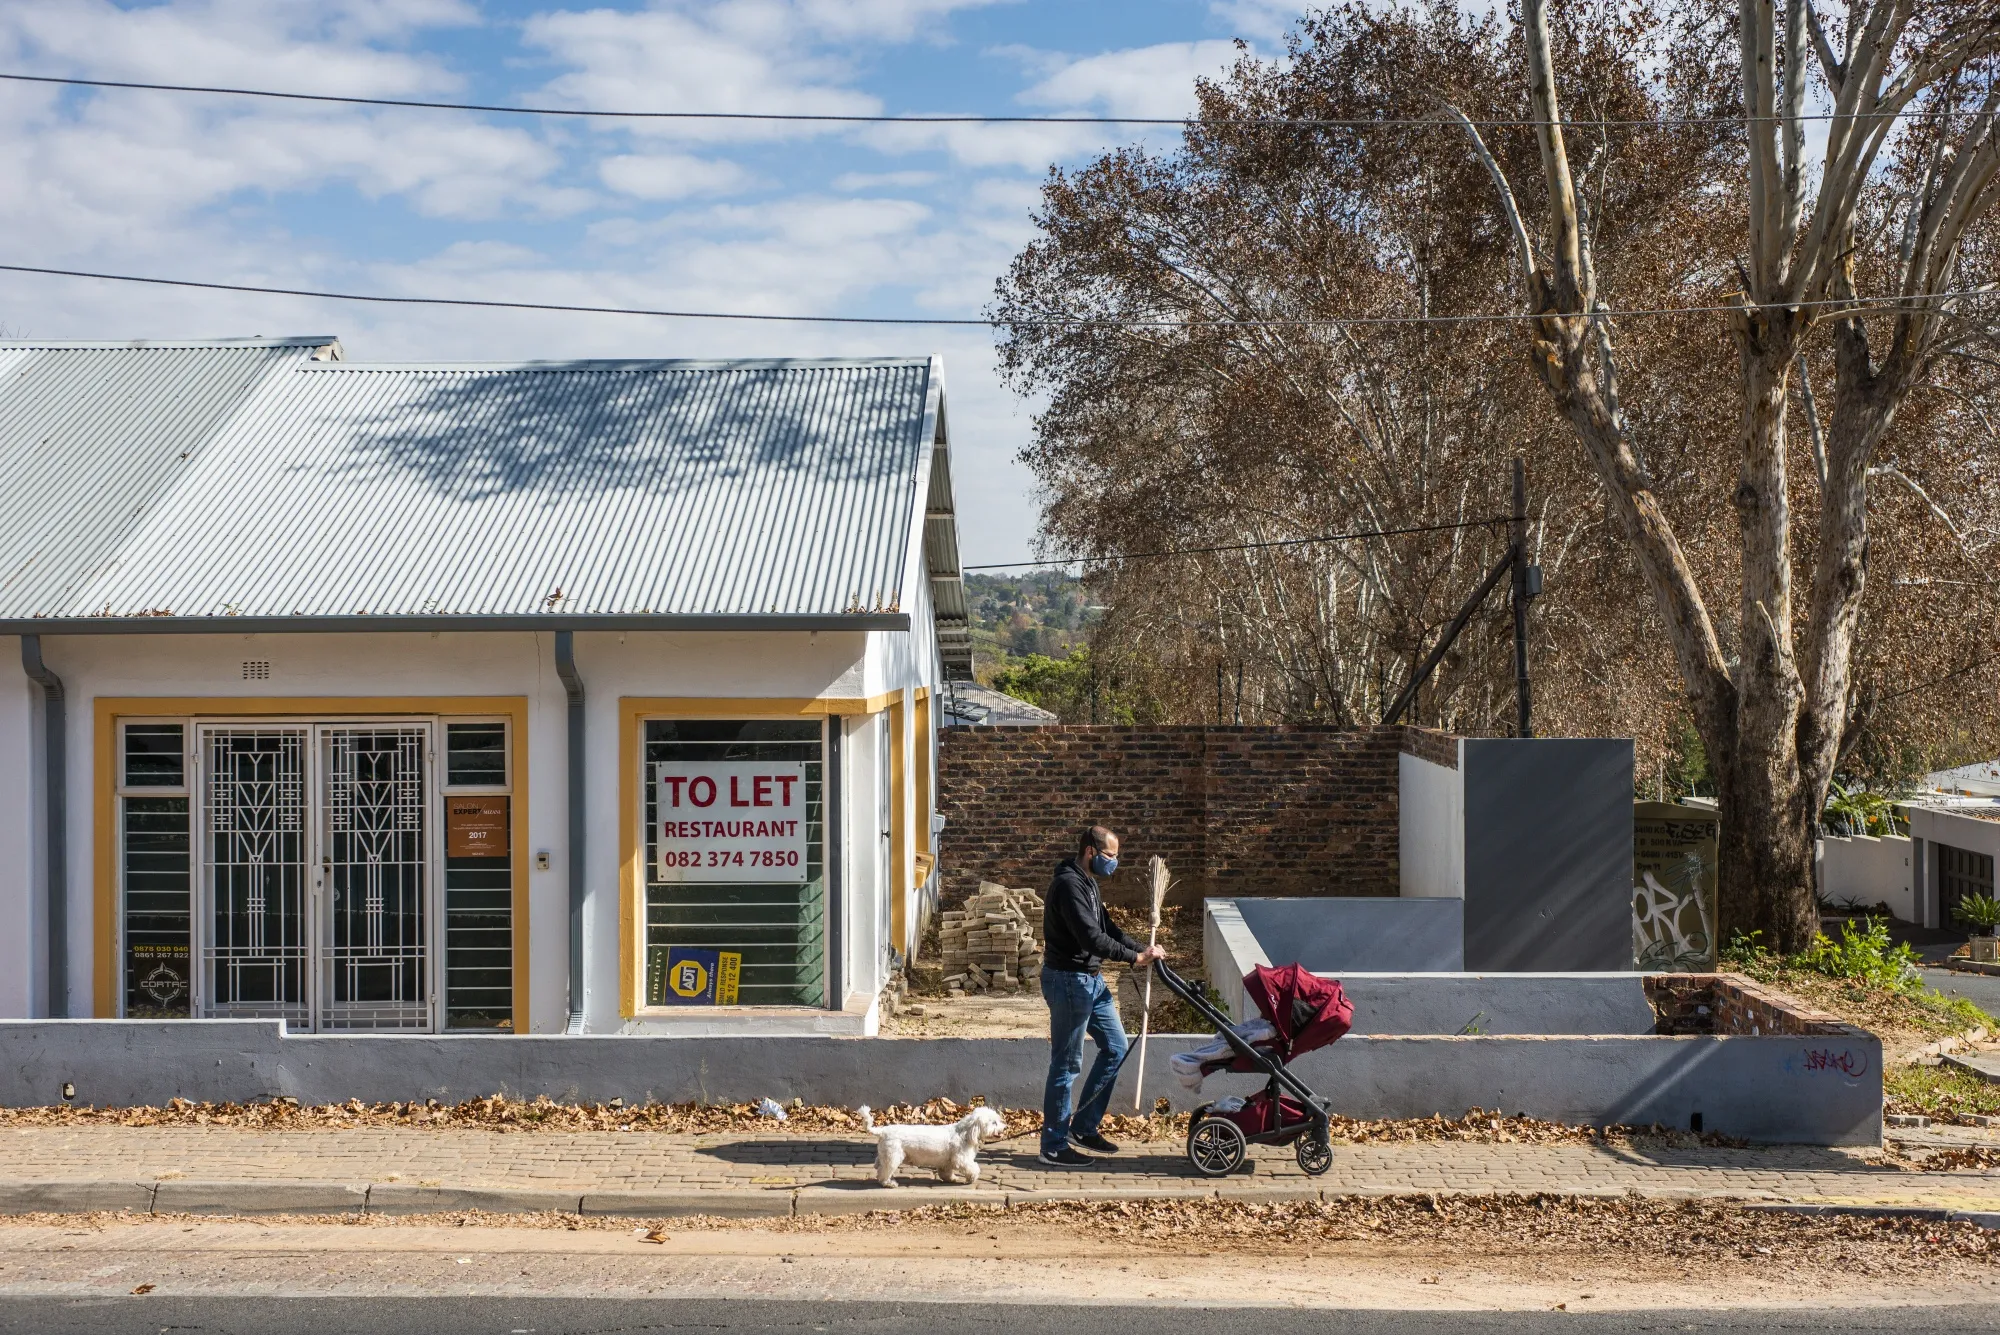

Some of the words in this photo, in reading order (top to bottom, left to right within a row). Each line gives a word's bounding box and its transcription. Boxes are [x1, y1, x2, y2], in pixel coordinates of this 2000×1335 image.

[664, 775, 717, 807] TO
[730, 775, 798, 807] LET
[664, 820, 798, 838] RESTAURANT
[665, 851, 702, 867] 082
[708, 851, 744, 867] 374
[750, 850, 798, 867] 7850
[652, 950, 662, 1001] FIDELITY
[682, 966, 696, 991] ADT
[720, 956, 728, 986] RESPONSE
[728, 972, 736, 981] 12
[728, 984, 735, 992] 12
